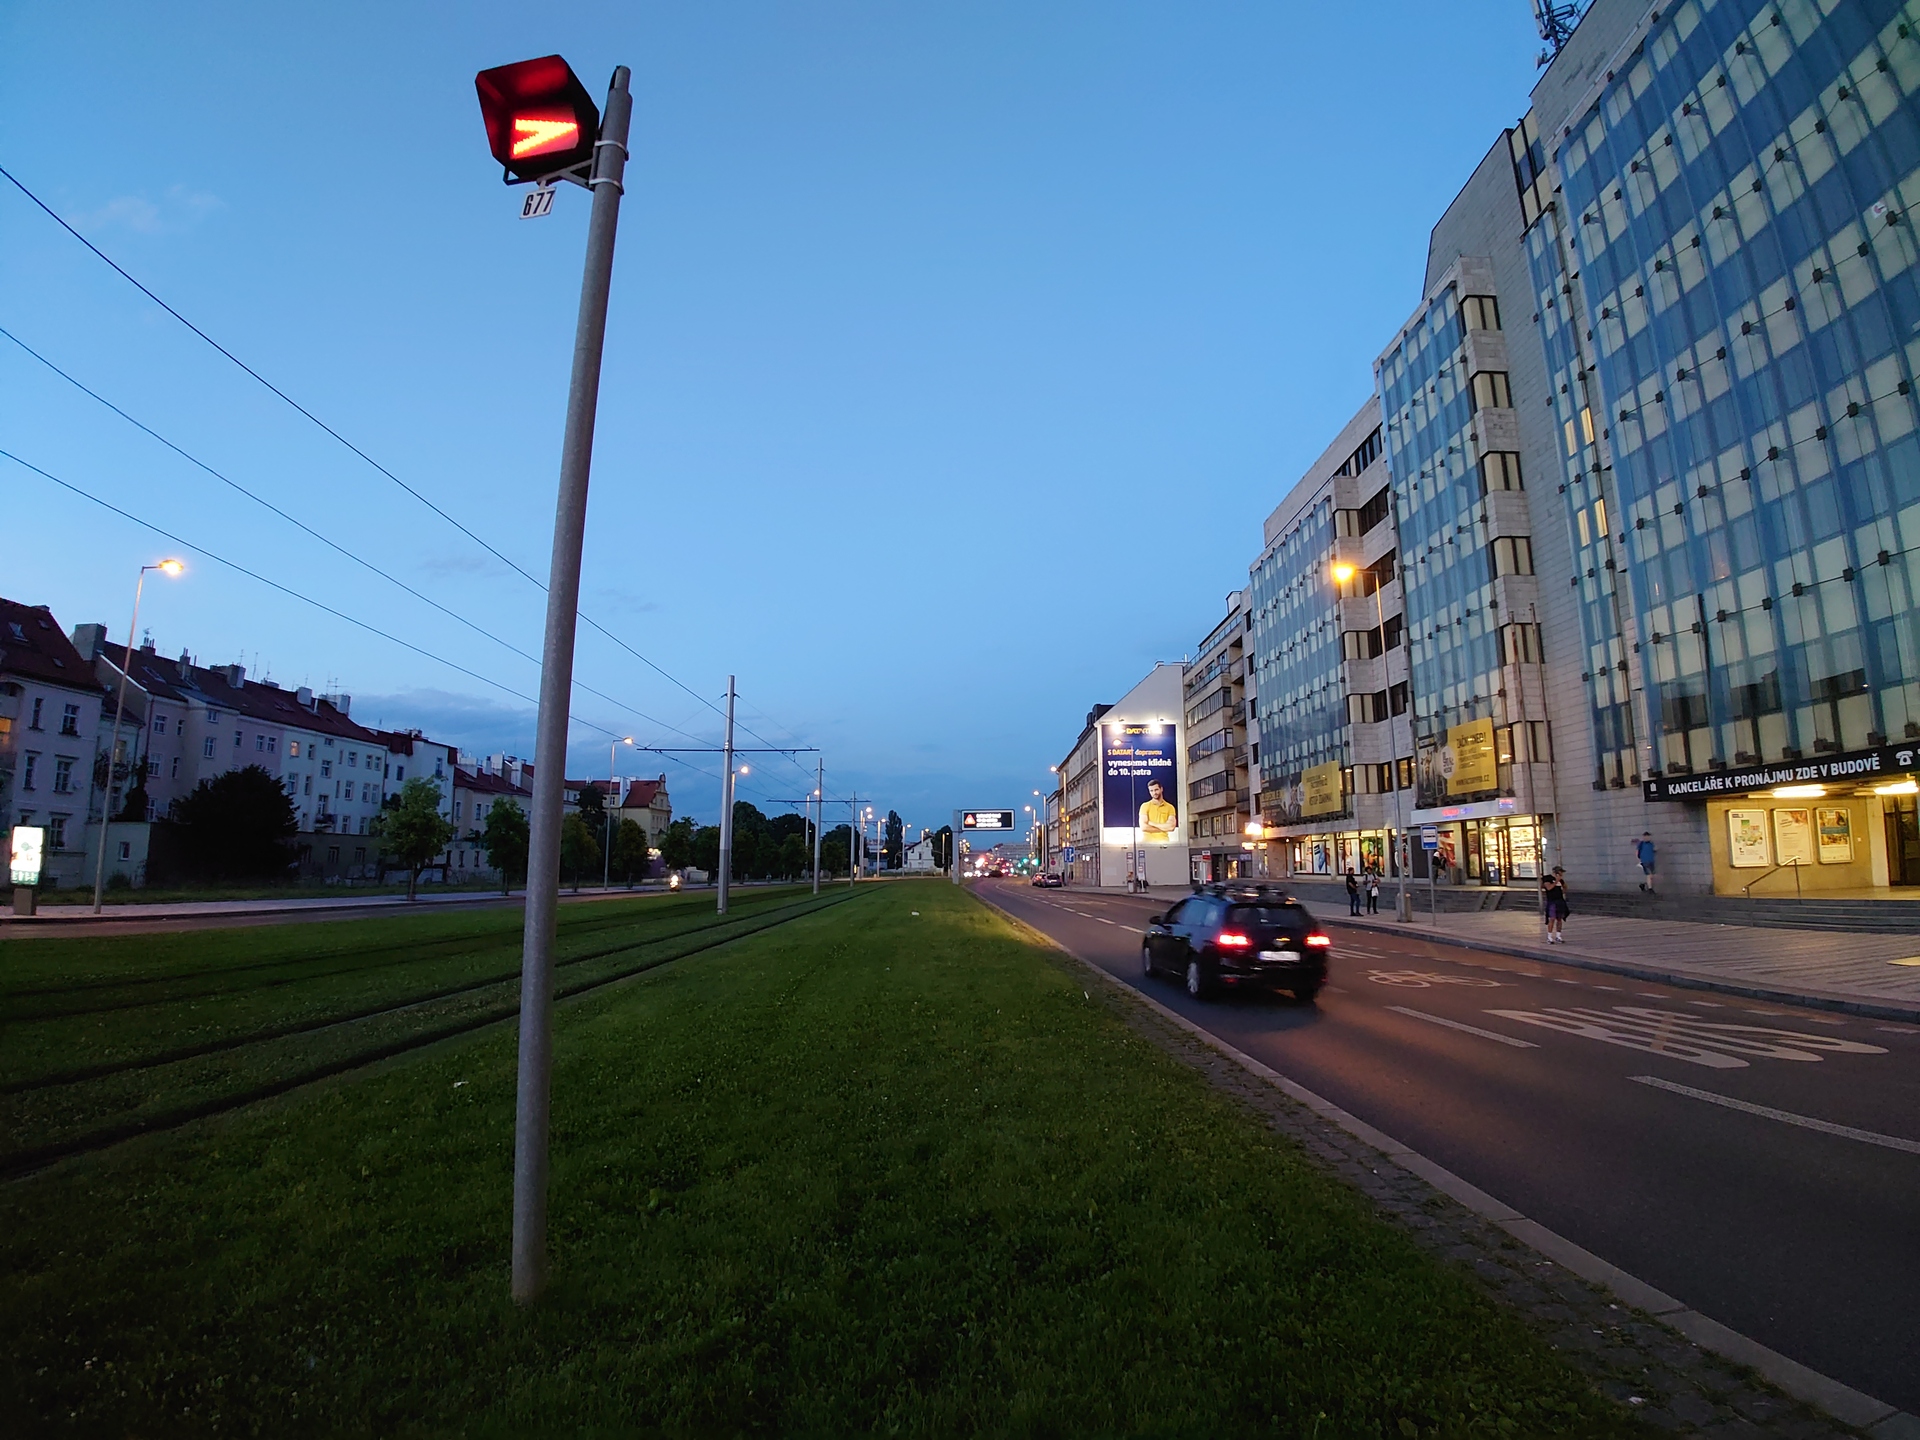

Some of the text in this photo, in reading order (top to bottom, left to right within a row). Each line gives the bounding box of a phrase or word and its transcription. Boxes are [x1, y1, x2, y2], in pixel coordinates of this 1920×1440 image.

[522, 190, 555, 216] 677
[1108, 768, 1118, 776] do
[1119, 768, 1131, 776] 10.
[1148, 758, 1172, 767] klidně
[1668, 753, 1881, 795] KANCELÁŘE K PRONÁJMU ZDE V BUDOVĚ
[1481, 1005, 1890, 1069] BUS
